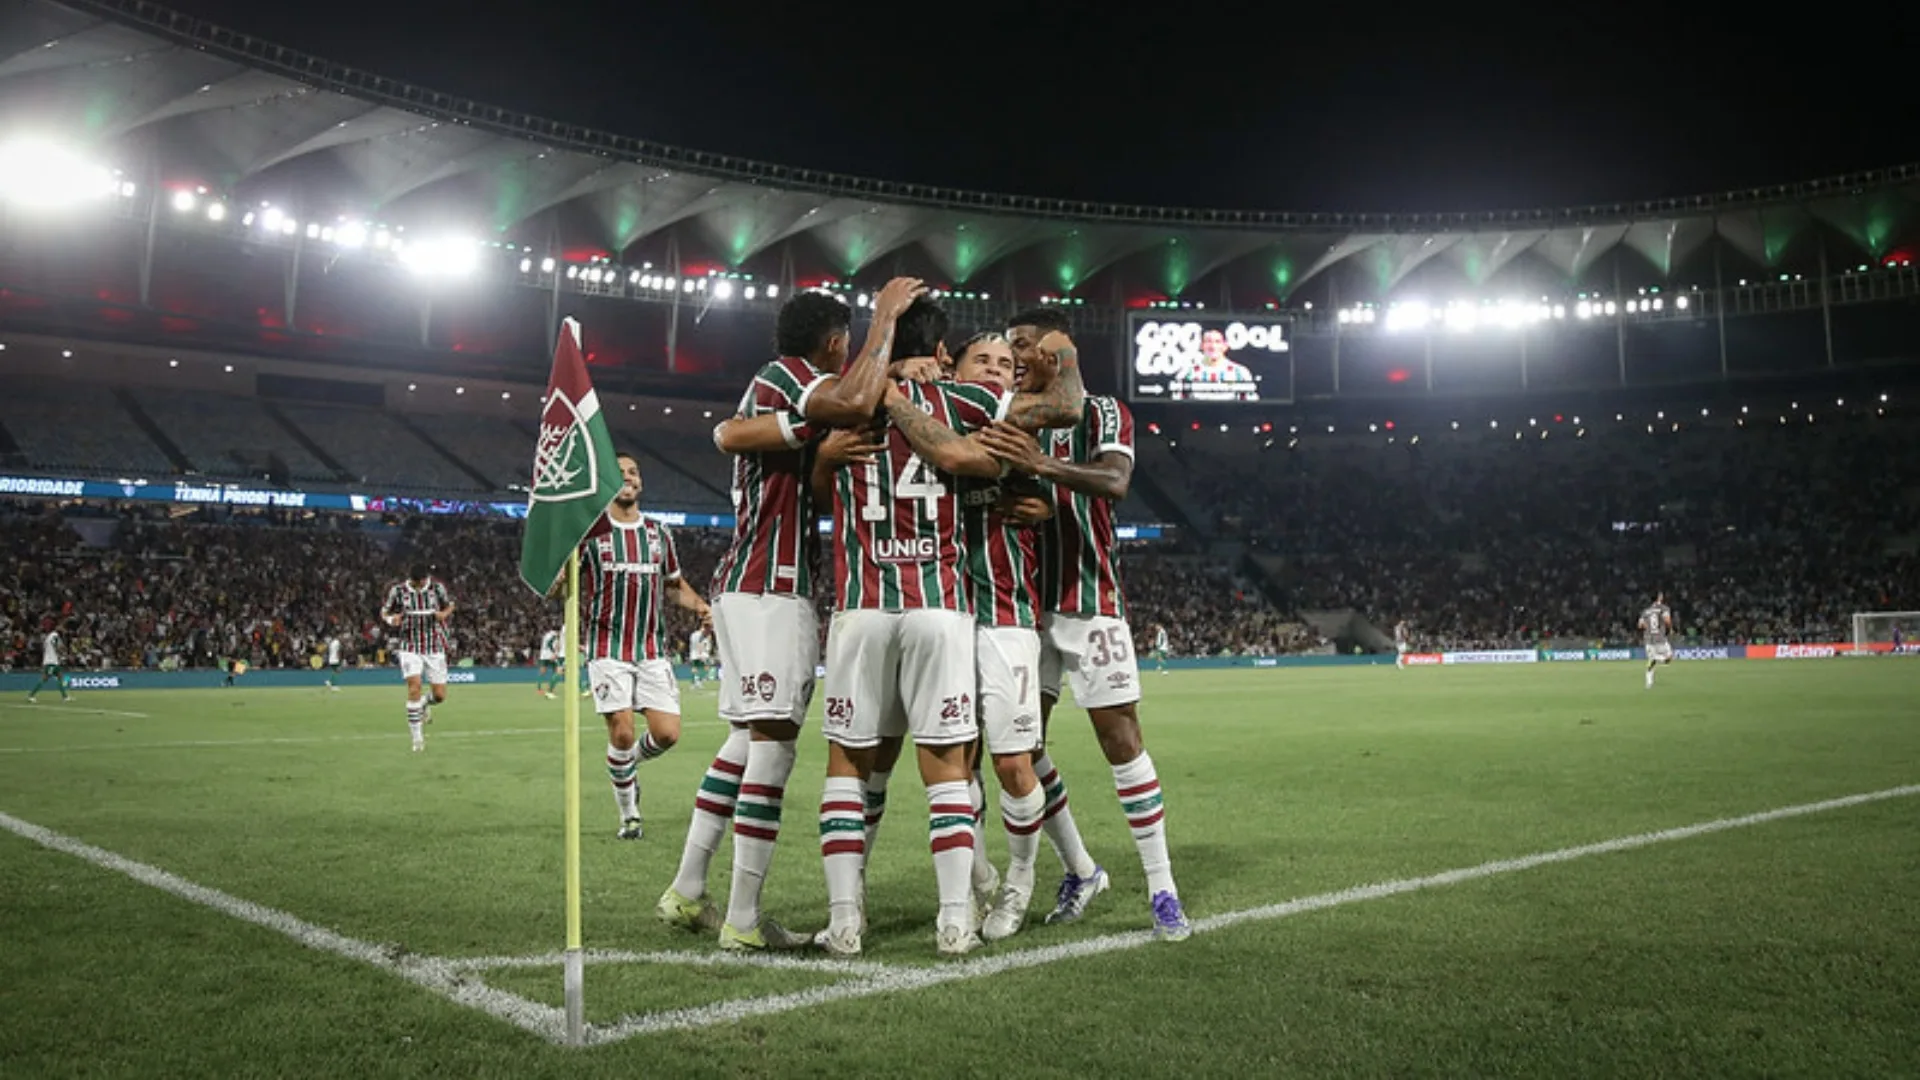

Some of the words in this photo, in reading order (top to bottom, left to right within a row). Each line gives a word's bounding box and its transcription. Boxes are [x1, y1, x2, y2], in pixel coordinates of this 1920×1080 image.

[862, 453, 945, 521] 14
[877, 534, 934, 557] UNIG
[1088, 626, 1128, 668] 35
[1775, 644, 1834, 658] Betano
[70, 677, 119, 688] SICOOB
[1012, 666, 1028, 705] 7
